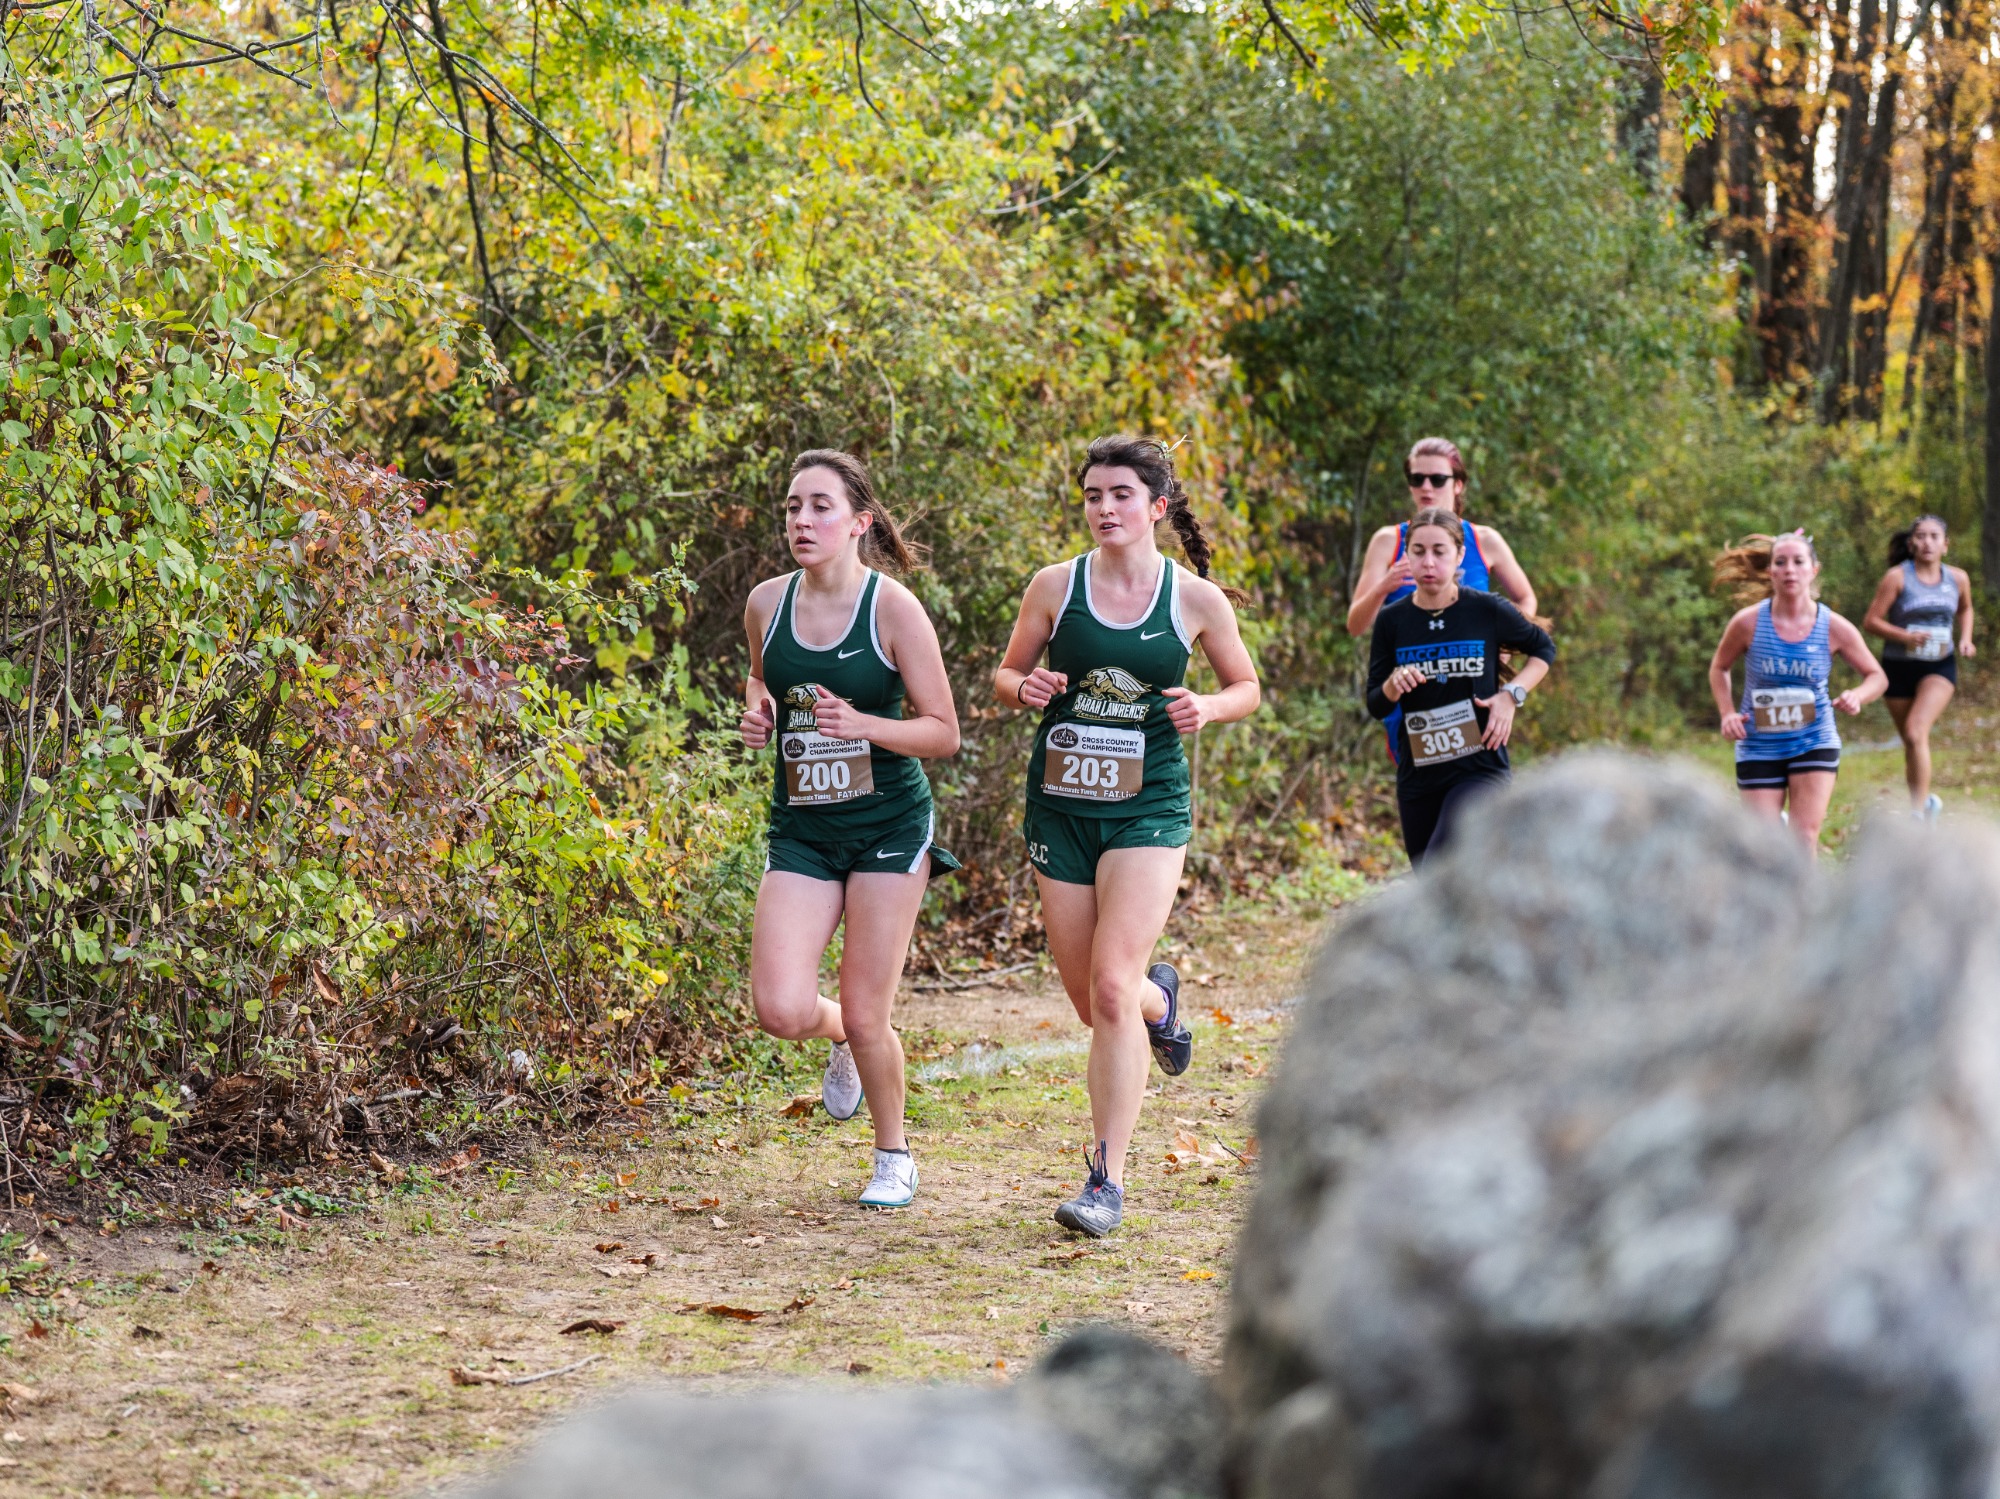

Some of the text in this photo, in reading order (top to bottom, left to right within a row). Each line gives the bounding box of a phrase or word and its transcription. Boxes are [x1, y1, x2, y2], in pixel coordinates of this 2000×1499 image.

[1396, 645, 1485, 665] MACCABEES
[1400, 657, 1484, 675] HLETICS
[1761, 656, 1818, 680] MSMC
[1074, 694, 1146, 719] SARAH LAWRENCE
[1766, 704, 1804, 726] 144
[789, 711, 813, 727] SARAH
[809, 746, 864, 756] CHAMPIONSHIPS
[1081, 736, 1139, 747] CROSS COUNTRY
[1081, 744, 1138, 754] CHAMPIONSHIPS
[1421, 727, 1465, 755] 303
[797, 761, 850, 792] 200
[1061, 755, 1120, 788] 203
[1080, 788, 1097, 797] Timing
